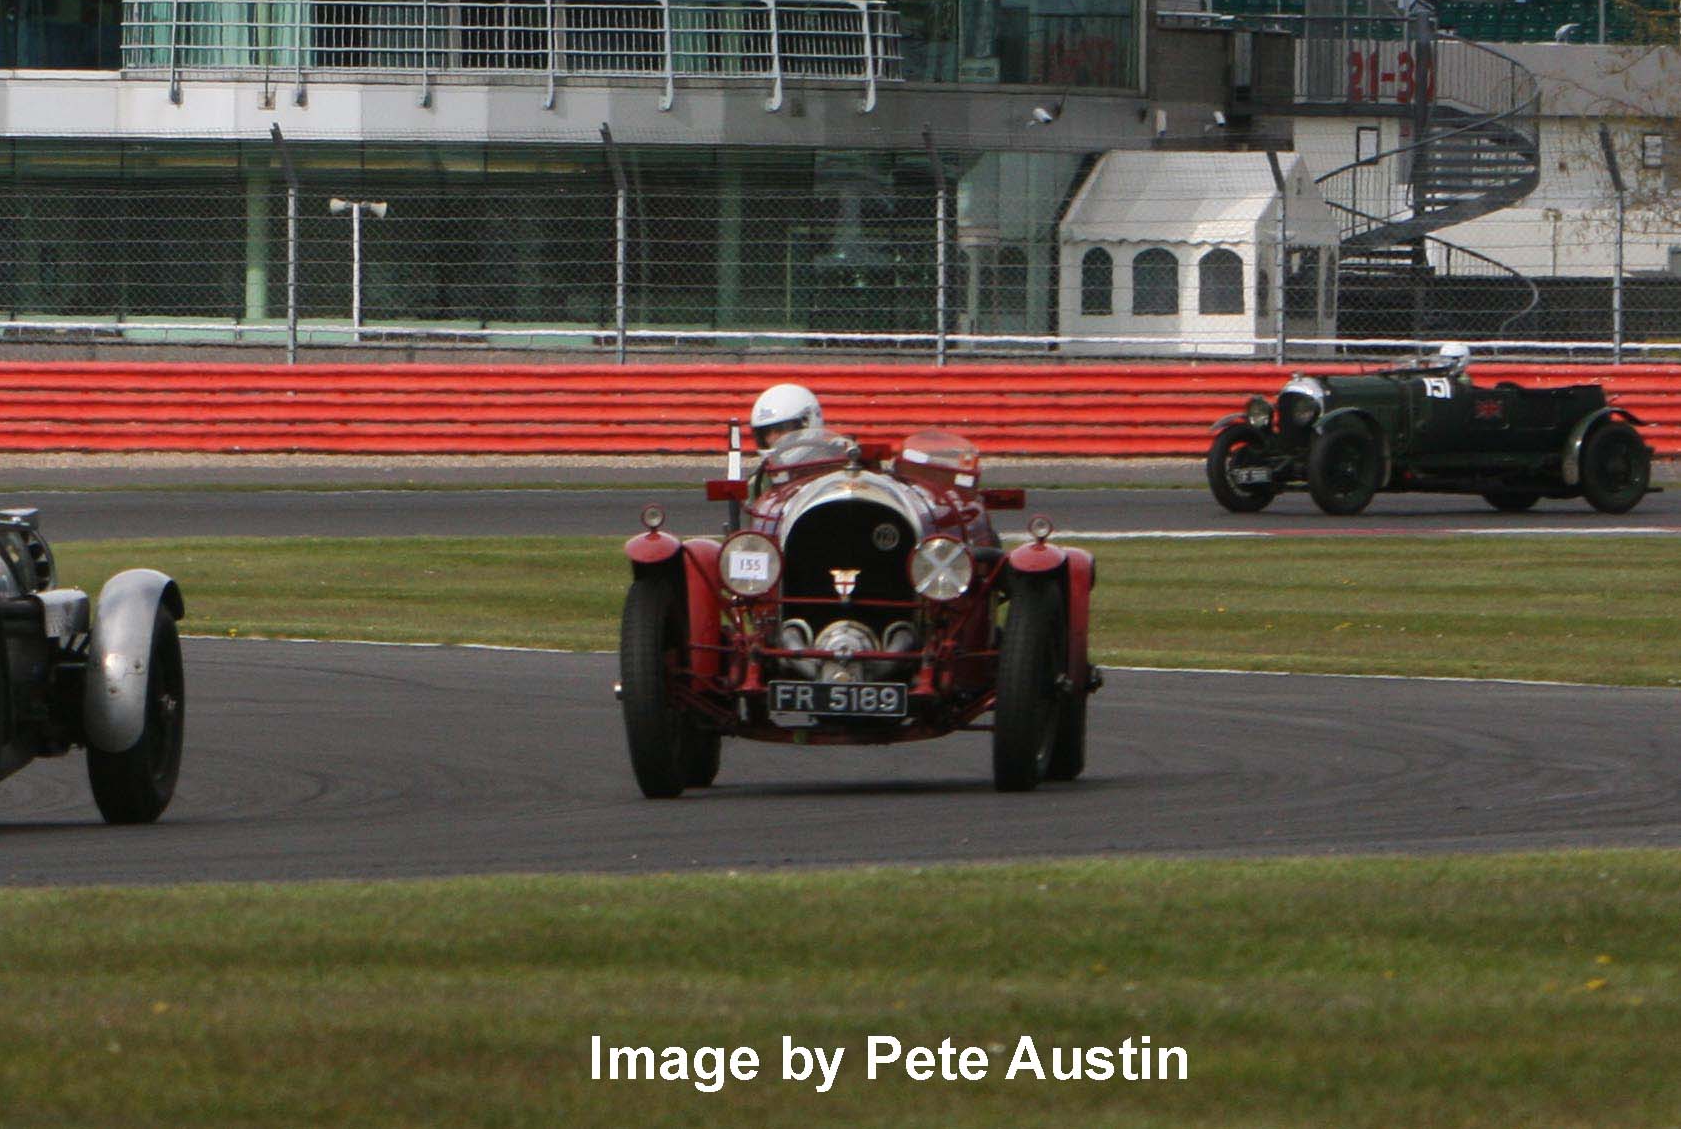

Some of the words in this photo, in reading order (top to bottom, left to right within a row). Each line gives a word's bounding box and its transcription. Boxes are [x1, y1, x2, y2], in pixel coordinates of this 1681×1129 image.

[1422, 377, 1452, 399] 151
[776, 685, 814, 710] FR
[829, 686, 899, 712] 5189
